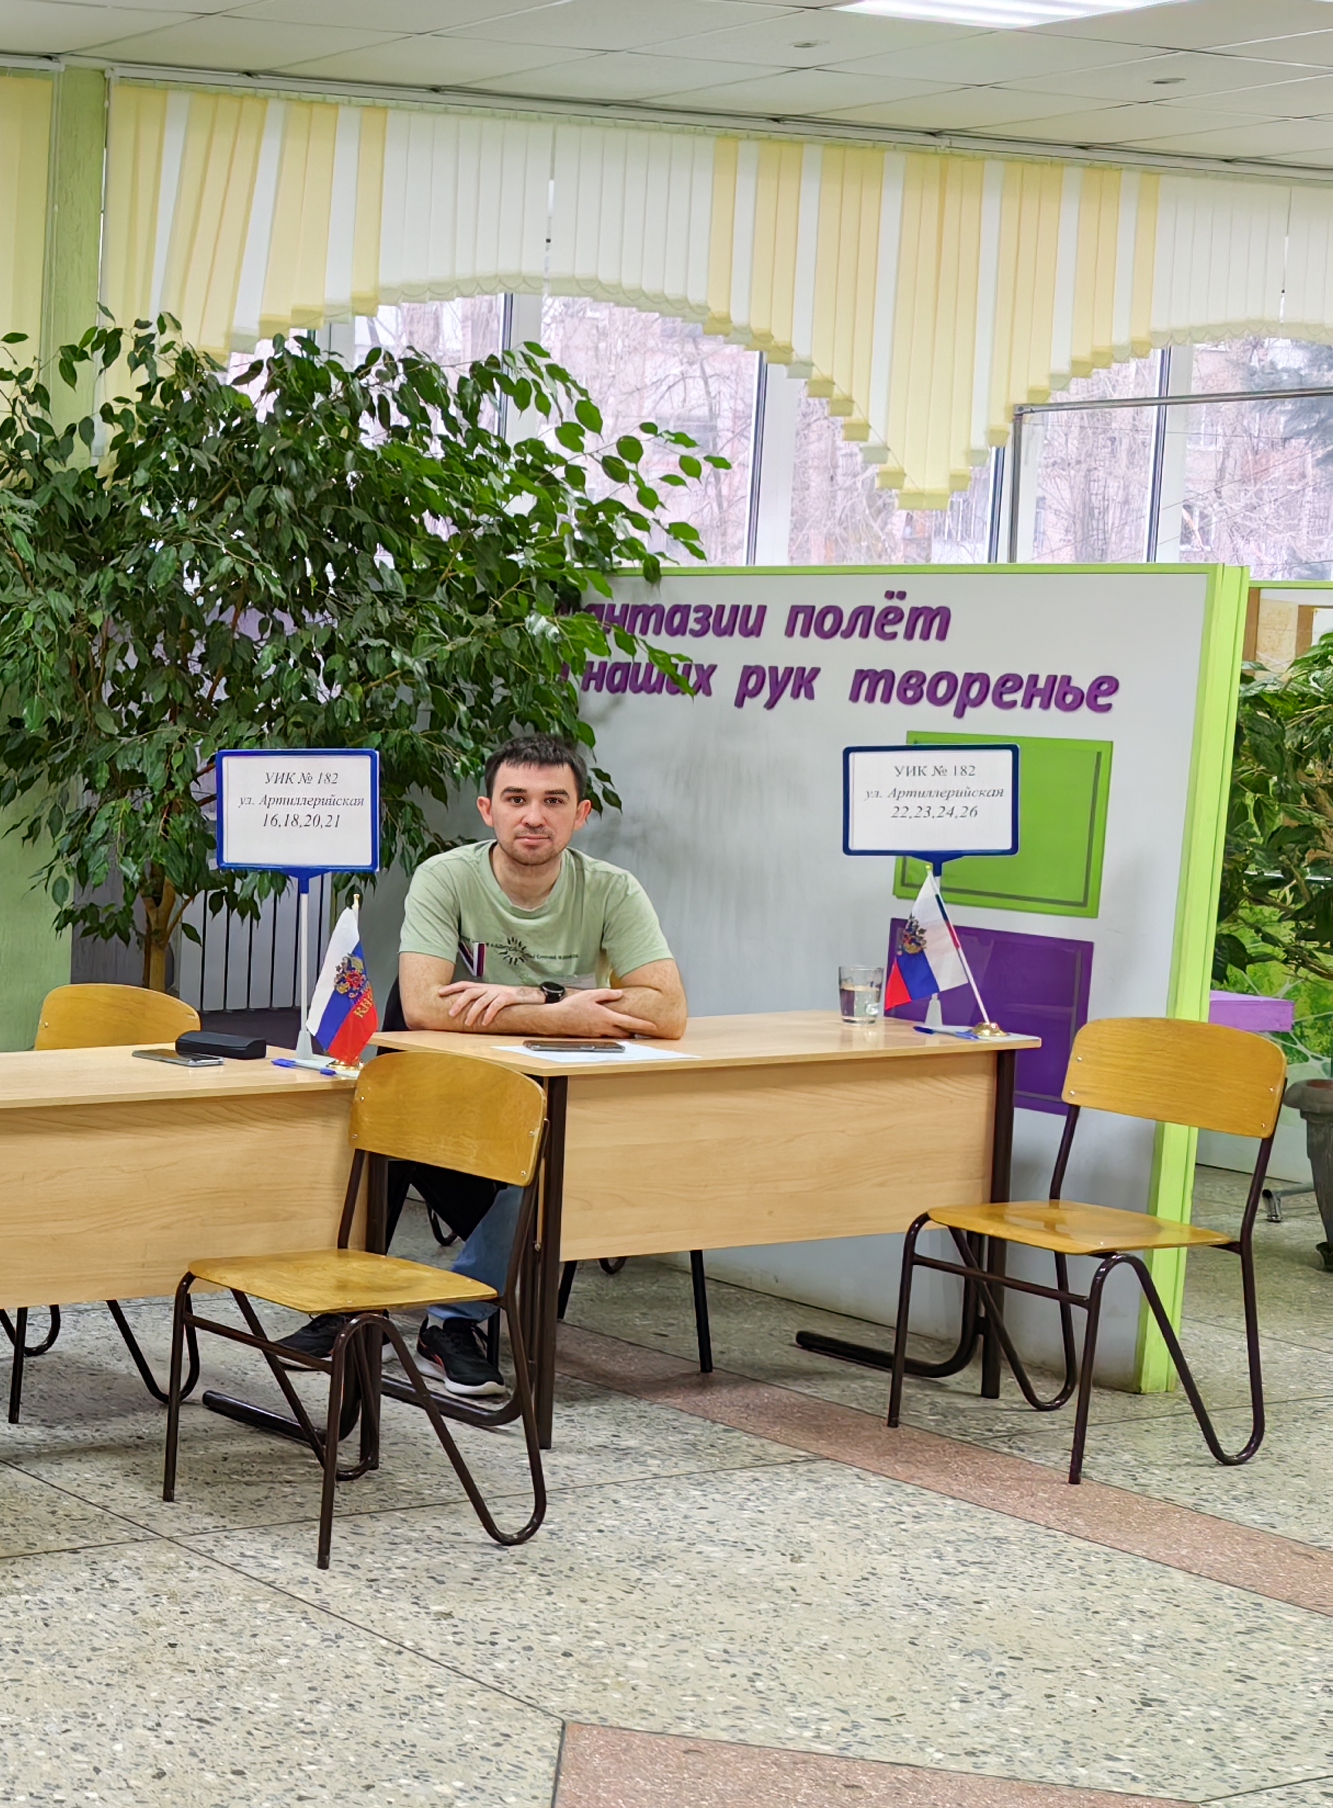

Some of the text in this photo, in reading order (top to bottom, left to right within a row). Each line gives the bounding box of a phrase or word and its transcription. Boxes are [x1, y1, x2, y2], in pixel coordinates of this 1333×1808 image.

[555, 590, 951, 642] нтазии полёт
[581, 660, 718, 698] наших
[734, 664, 821, 710] рук
[848, 668, 1120, 719] творенье
[264, 772, 339, 785] УИК № 182
[894, 765, 977, 777] УИК № 182
[864, 786, 1005, 801] ул. Артиллерийская
[238, 794, 365, 809] ул. Артиллерийская
[262, 813, 341, 829] 16,18,20,21
